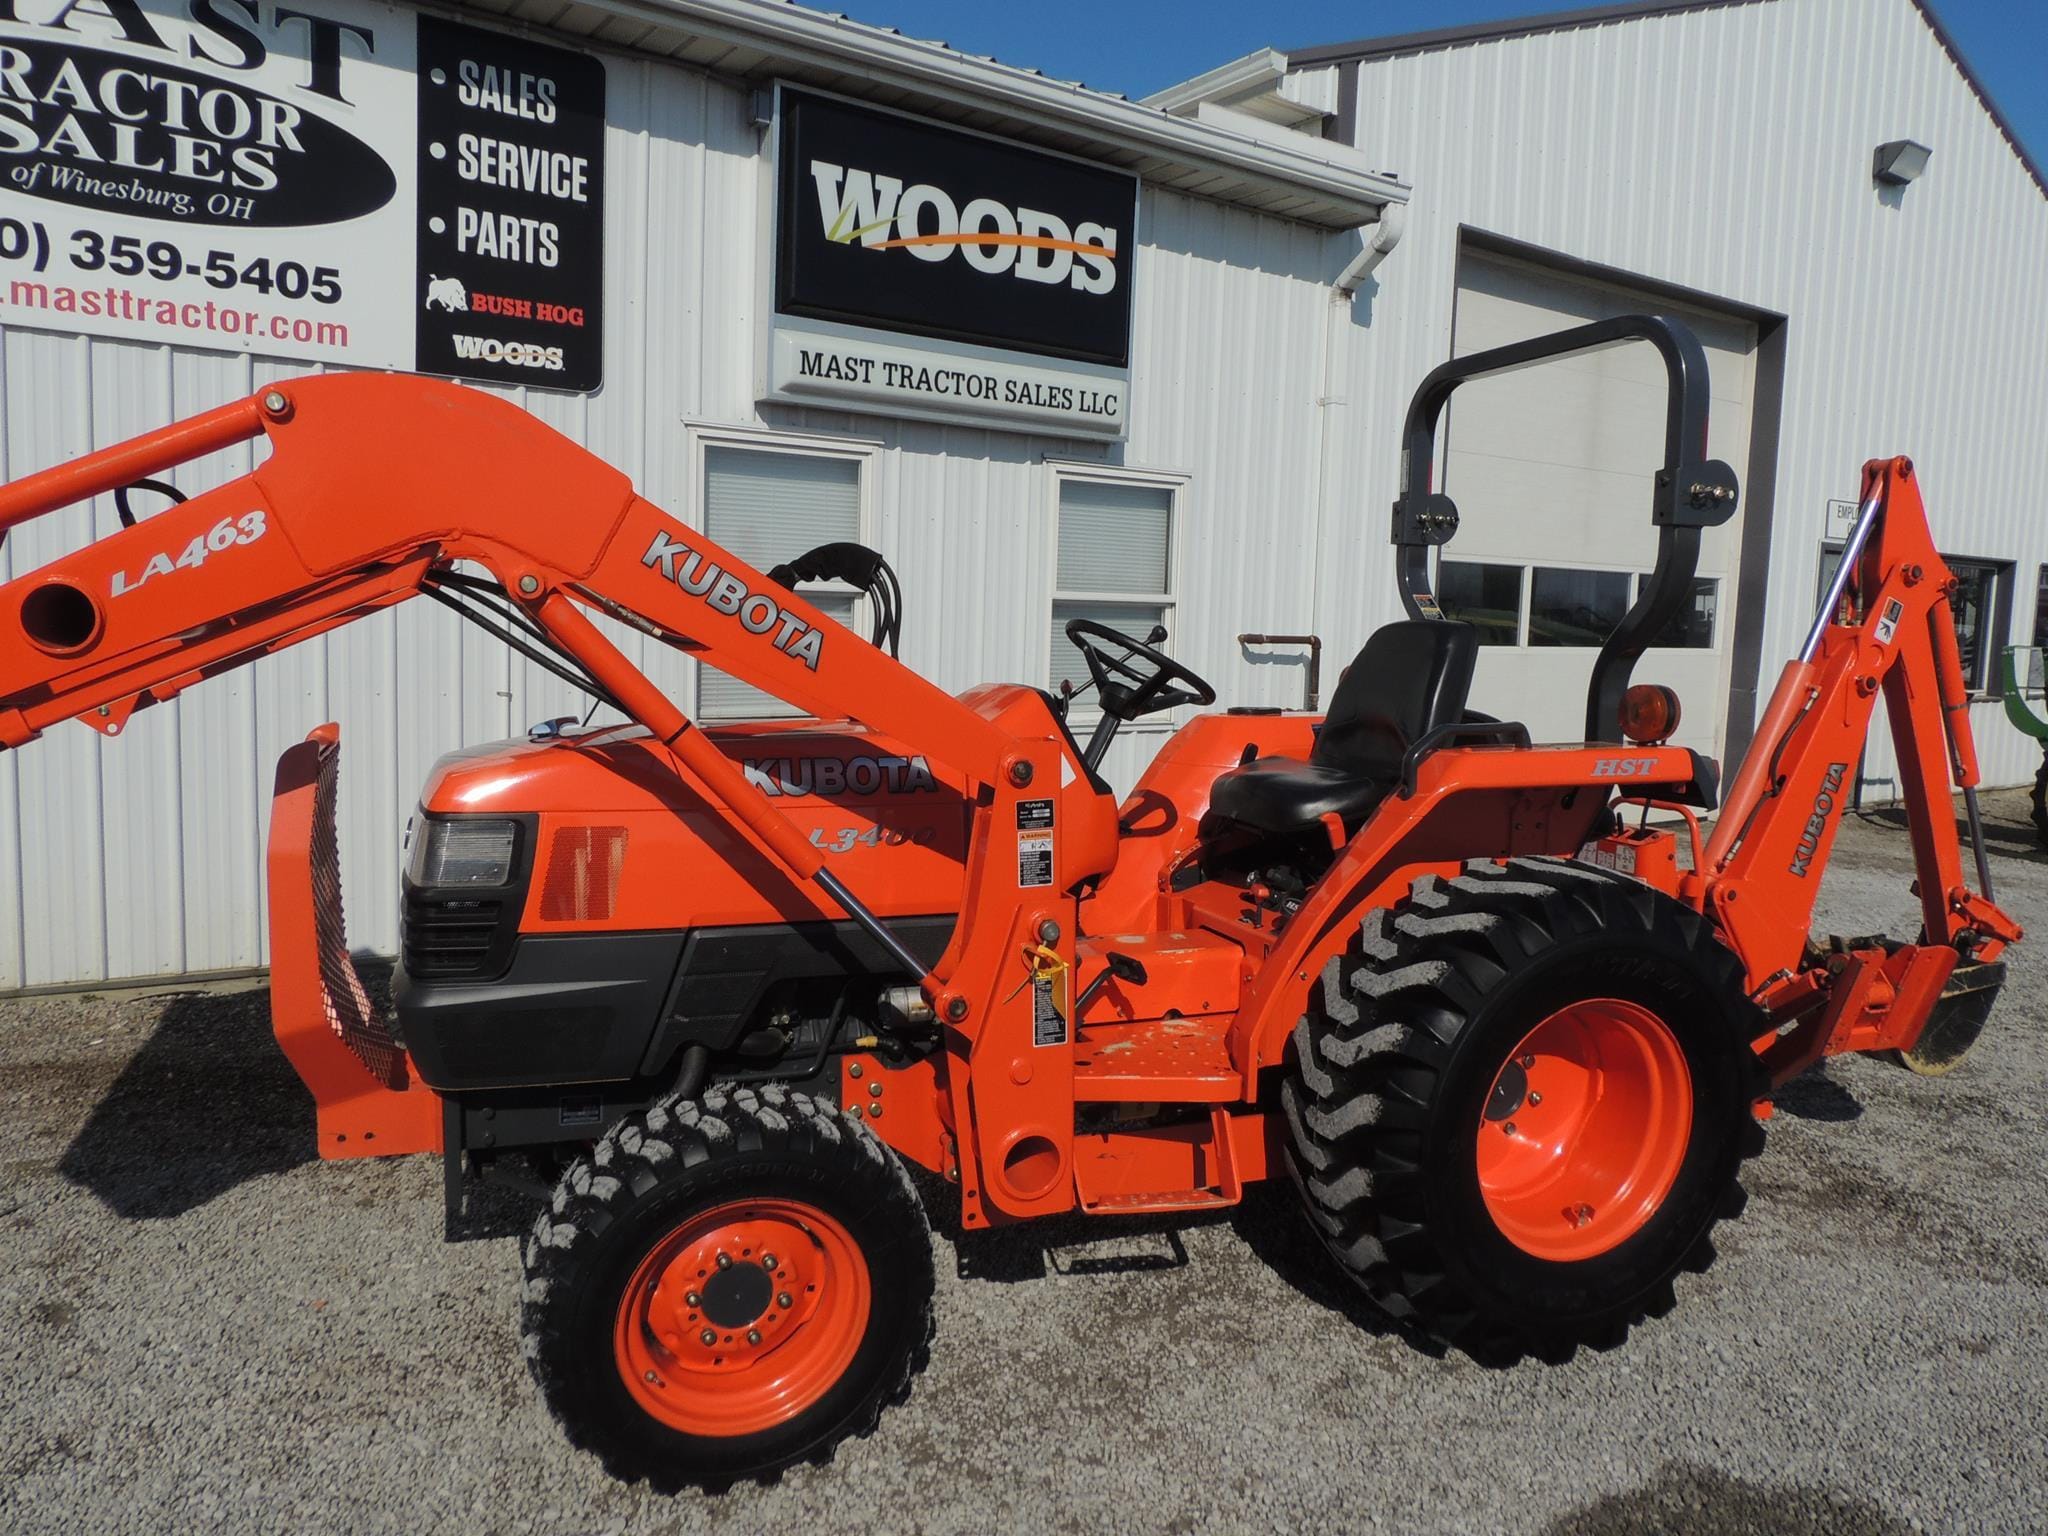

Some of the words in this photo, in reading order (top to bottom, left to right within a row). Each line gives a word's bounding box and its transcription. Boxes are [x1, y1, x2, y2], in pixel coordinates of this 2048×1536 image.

[0, 46, 305, 153] RACTOR
[458, 59, 556, 124] SALES
[0, 99, 278, 191] SALES
[457, 132, 587, 203] SERVICE
[11, 162, 46, 189] of
[50, 165, 196, 216] Winesburg,
[207, 193, 255, 219] OH
[457, 206, 559, 268] PARTS
[811, 159, 1117, 295] WOODS
[69, 229, 343, 304] 359-5405
[472, 293, 531, 318] BUSH
[536, 303, 583, 326] HOG
[453, 334, 564, 371] WOODS
[800, 350, 874, 383] MAST
[883, 362, 998, 400] TRACTOR
[1005, 379, 1072, 410] SALES
[1079, 390, 1117, 416] LLC
[111, 510, 266, 598] LA463
[641, 530, 825, 673] KUBOTA
[743, 756, 938, 797] KUBOTA
[1590, 758, 1658, 776] HST
[1788, 761, 1848, 878] KUBOTA
